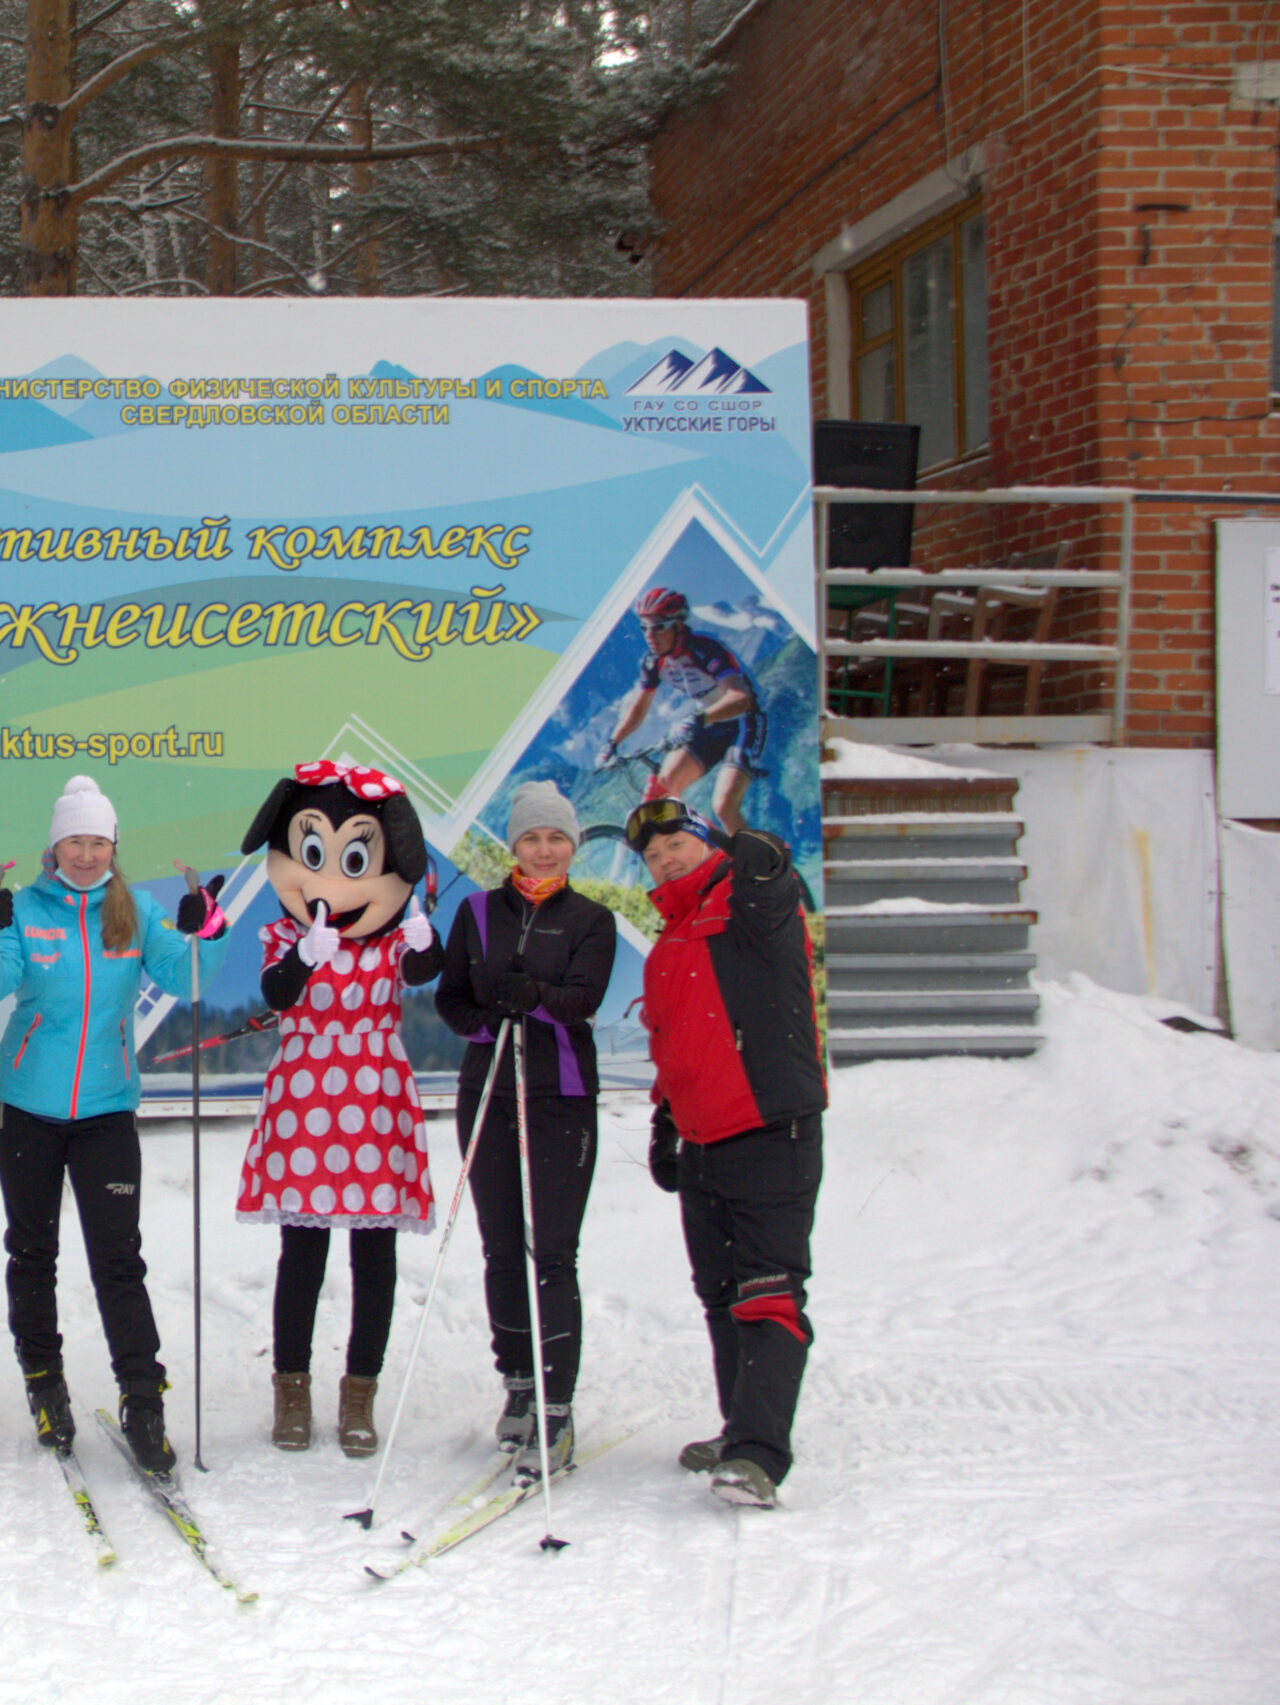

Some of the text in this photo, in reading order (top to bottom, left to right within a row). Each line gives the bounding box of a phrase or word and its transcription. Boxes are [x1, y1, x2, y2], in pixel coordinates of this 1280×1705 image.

[169, 373, 340, 399] ФИЗИЧЕСКОЙ
[348, 378, 477, 399] КУЛЬТУРЫ
[485, 378, 502, 398] И
[510, 378, 608, 398] СПОРТА
[633, 400, 762, 412] ГАУ СО СШОР
[121, 401, 449, 429] СВЕРДЛОВСКОЙ ОБЛАСТИ
[622, 416, 775, 432] УКТУССКИЕ ГОРЫ
[248, 523, 531, 571] комплекс
[24, 925, 67, 940] LUKOIL
[105, 1183, 136, 1195] RAY
